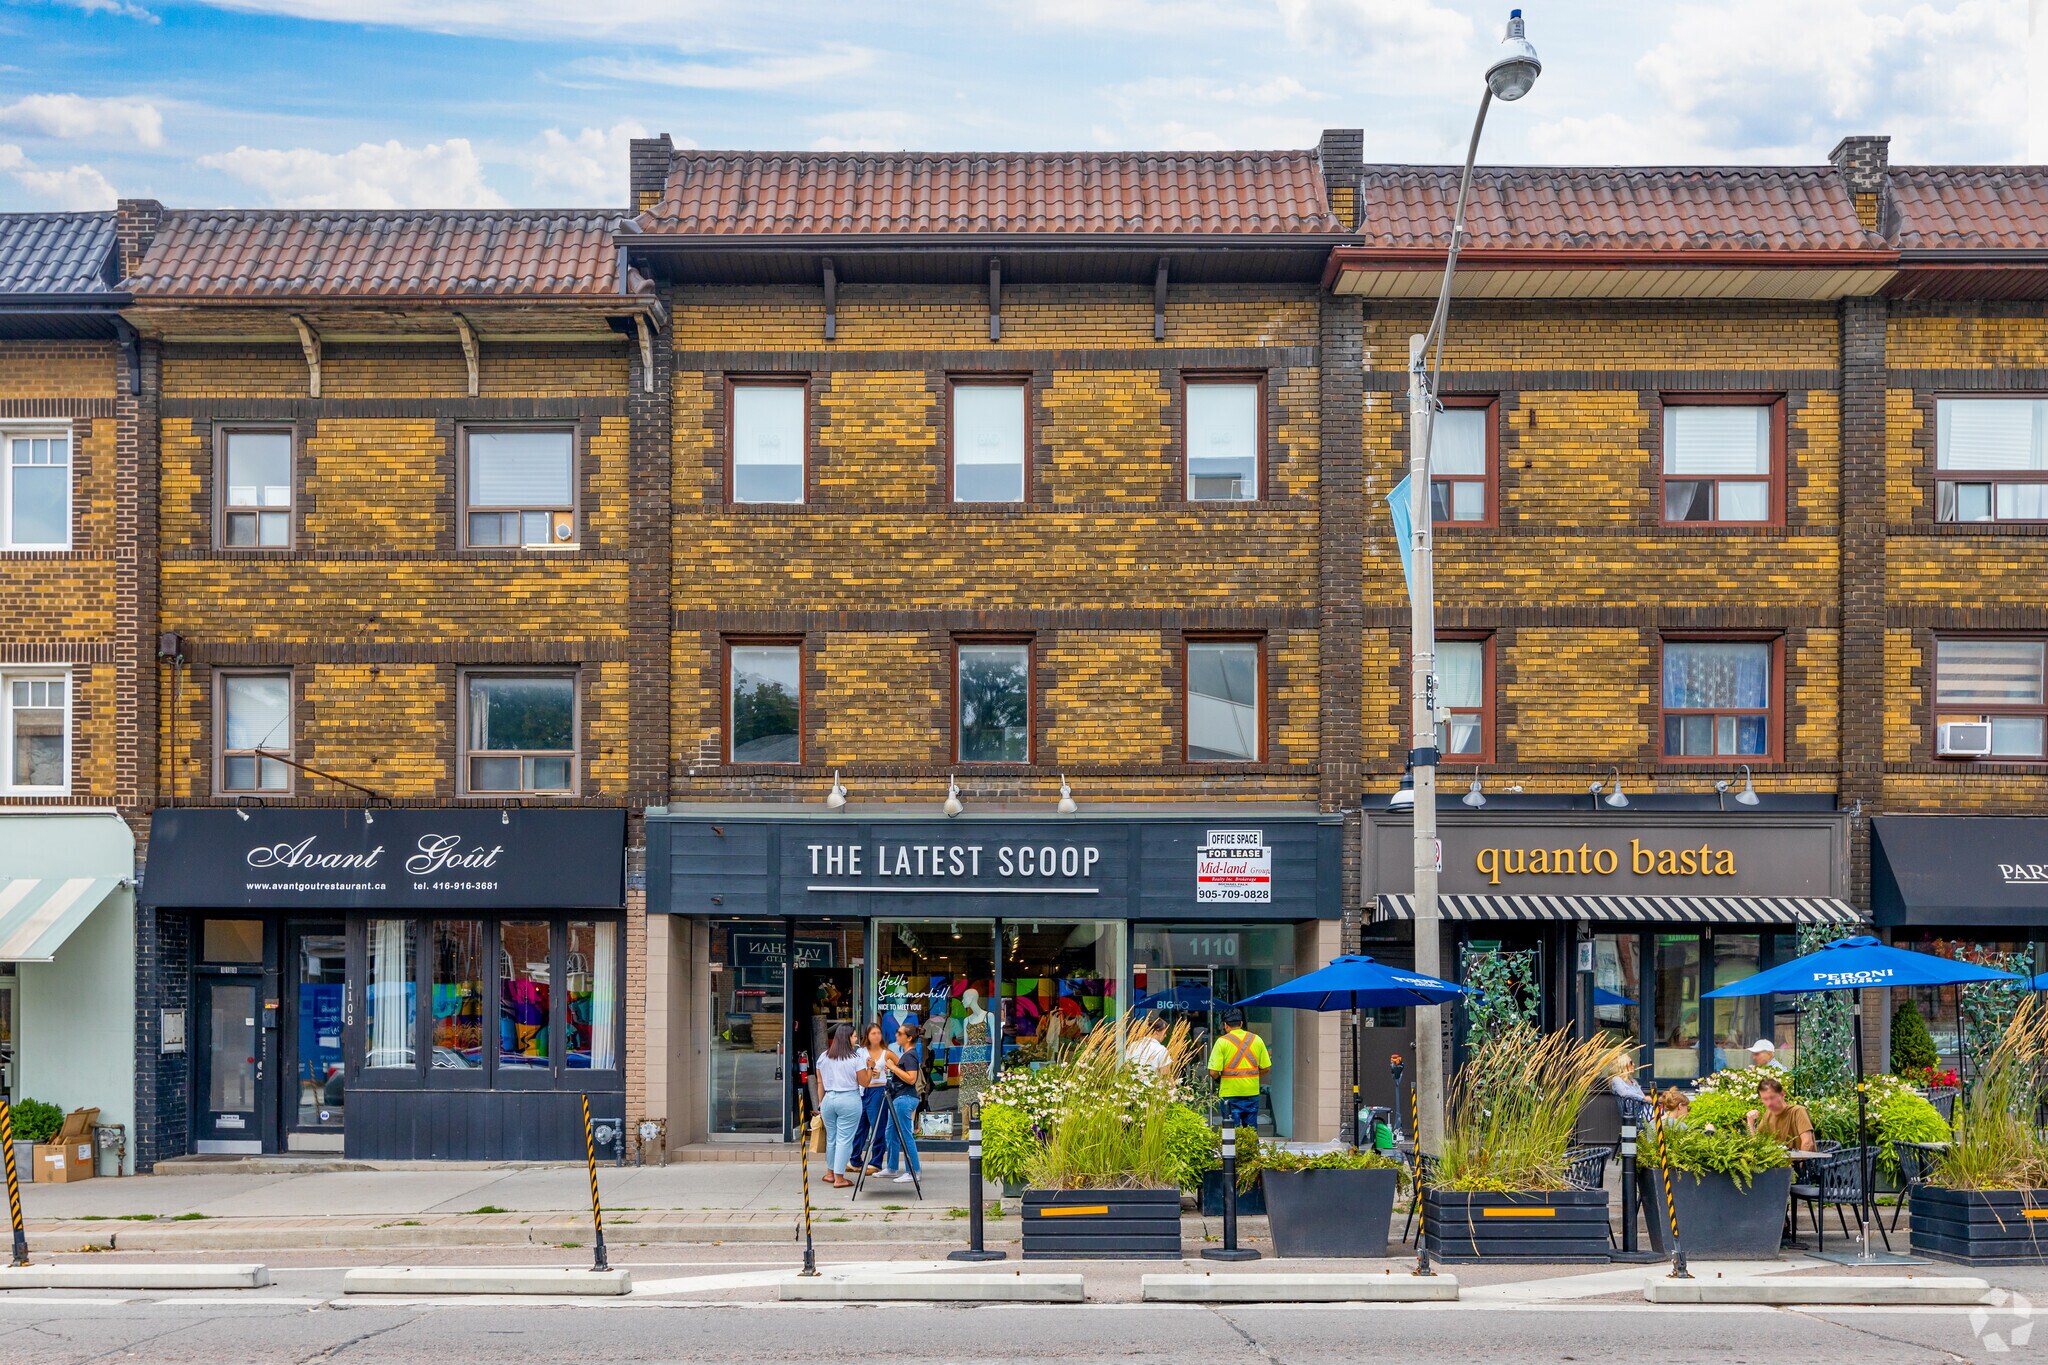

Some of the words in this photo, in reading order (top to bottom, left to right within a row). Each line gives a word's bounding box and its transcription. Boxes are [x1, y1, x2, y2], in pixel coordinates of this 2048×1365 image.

[1212, 834, 1235, 844] OFFICE
[1237, 834, 1257, 844] SPACE
[247, 835, 385, 868] Avant
[405, 833, 504, 875] Goût
[807, 845, 862, 875] THE
[879, 845, 983, 876] LATEST
[998, 846, 1100, 877] SCOOP
[1476, 842, 1618, 884] quanto
[1630, 838, 1737, 875] basta
[1199, 862, 1248, 874] Mid-land
[246, 882, 386, 891] www.avantgoutrestaurant.ca
[413, 882, 430, 890] tel.
[432, 882, 498, 890] 416-916-3681
[1199, 890, 1269, 898] 905-709-0828
[1189, 938, 1236, 956] 1110
[878, 974, 908, 986] Hello
[1813, 969, 1893, 981] PERONI
[878, 986, 952, 1001] Summerhill
